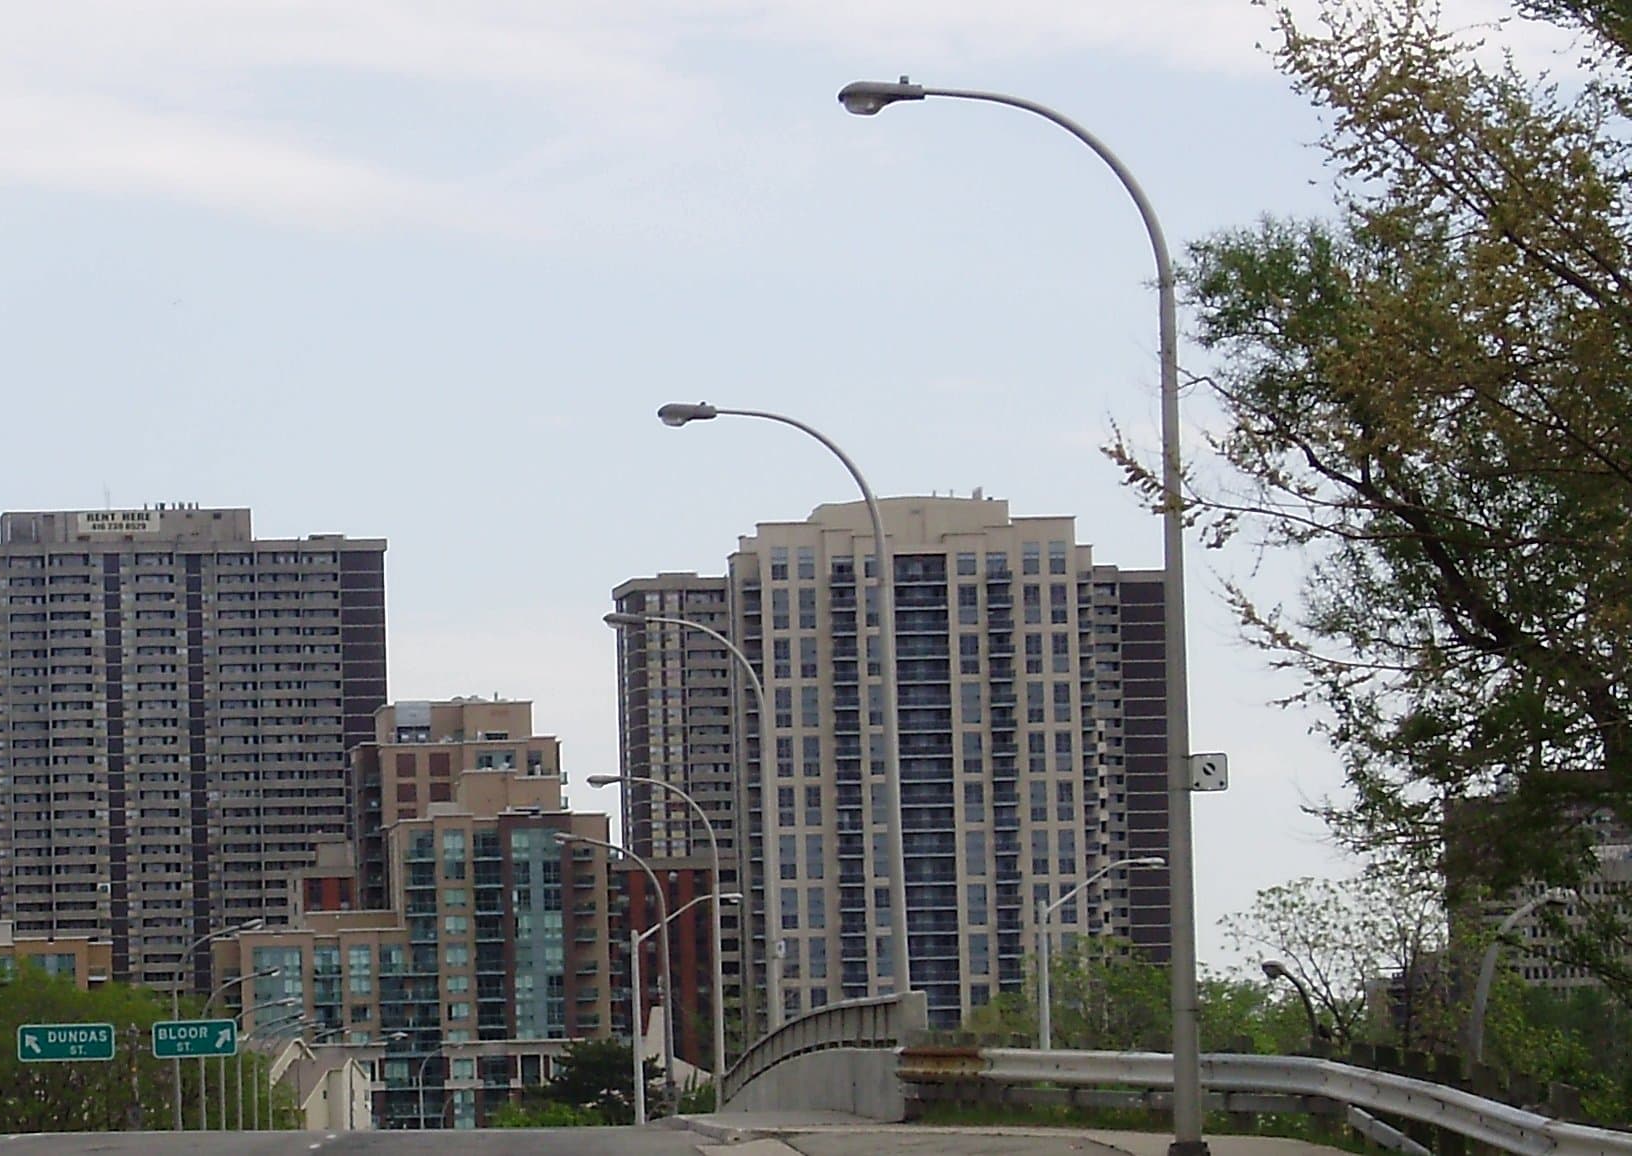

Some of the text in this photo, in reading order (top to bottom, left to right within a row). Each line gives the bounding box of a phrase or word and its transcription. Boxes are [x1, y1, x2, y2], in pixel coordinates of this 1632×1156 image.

[87, 513, 150, 522] RENT HERE
[47, 1030, 108, 1043] DUNDAS
[157, 1026, 208, 1040] BLOOR
[69, 1045, 87, 1055] ST.
[176, 1042, 194, 1052] ST.
